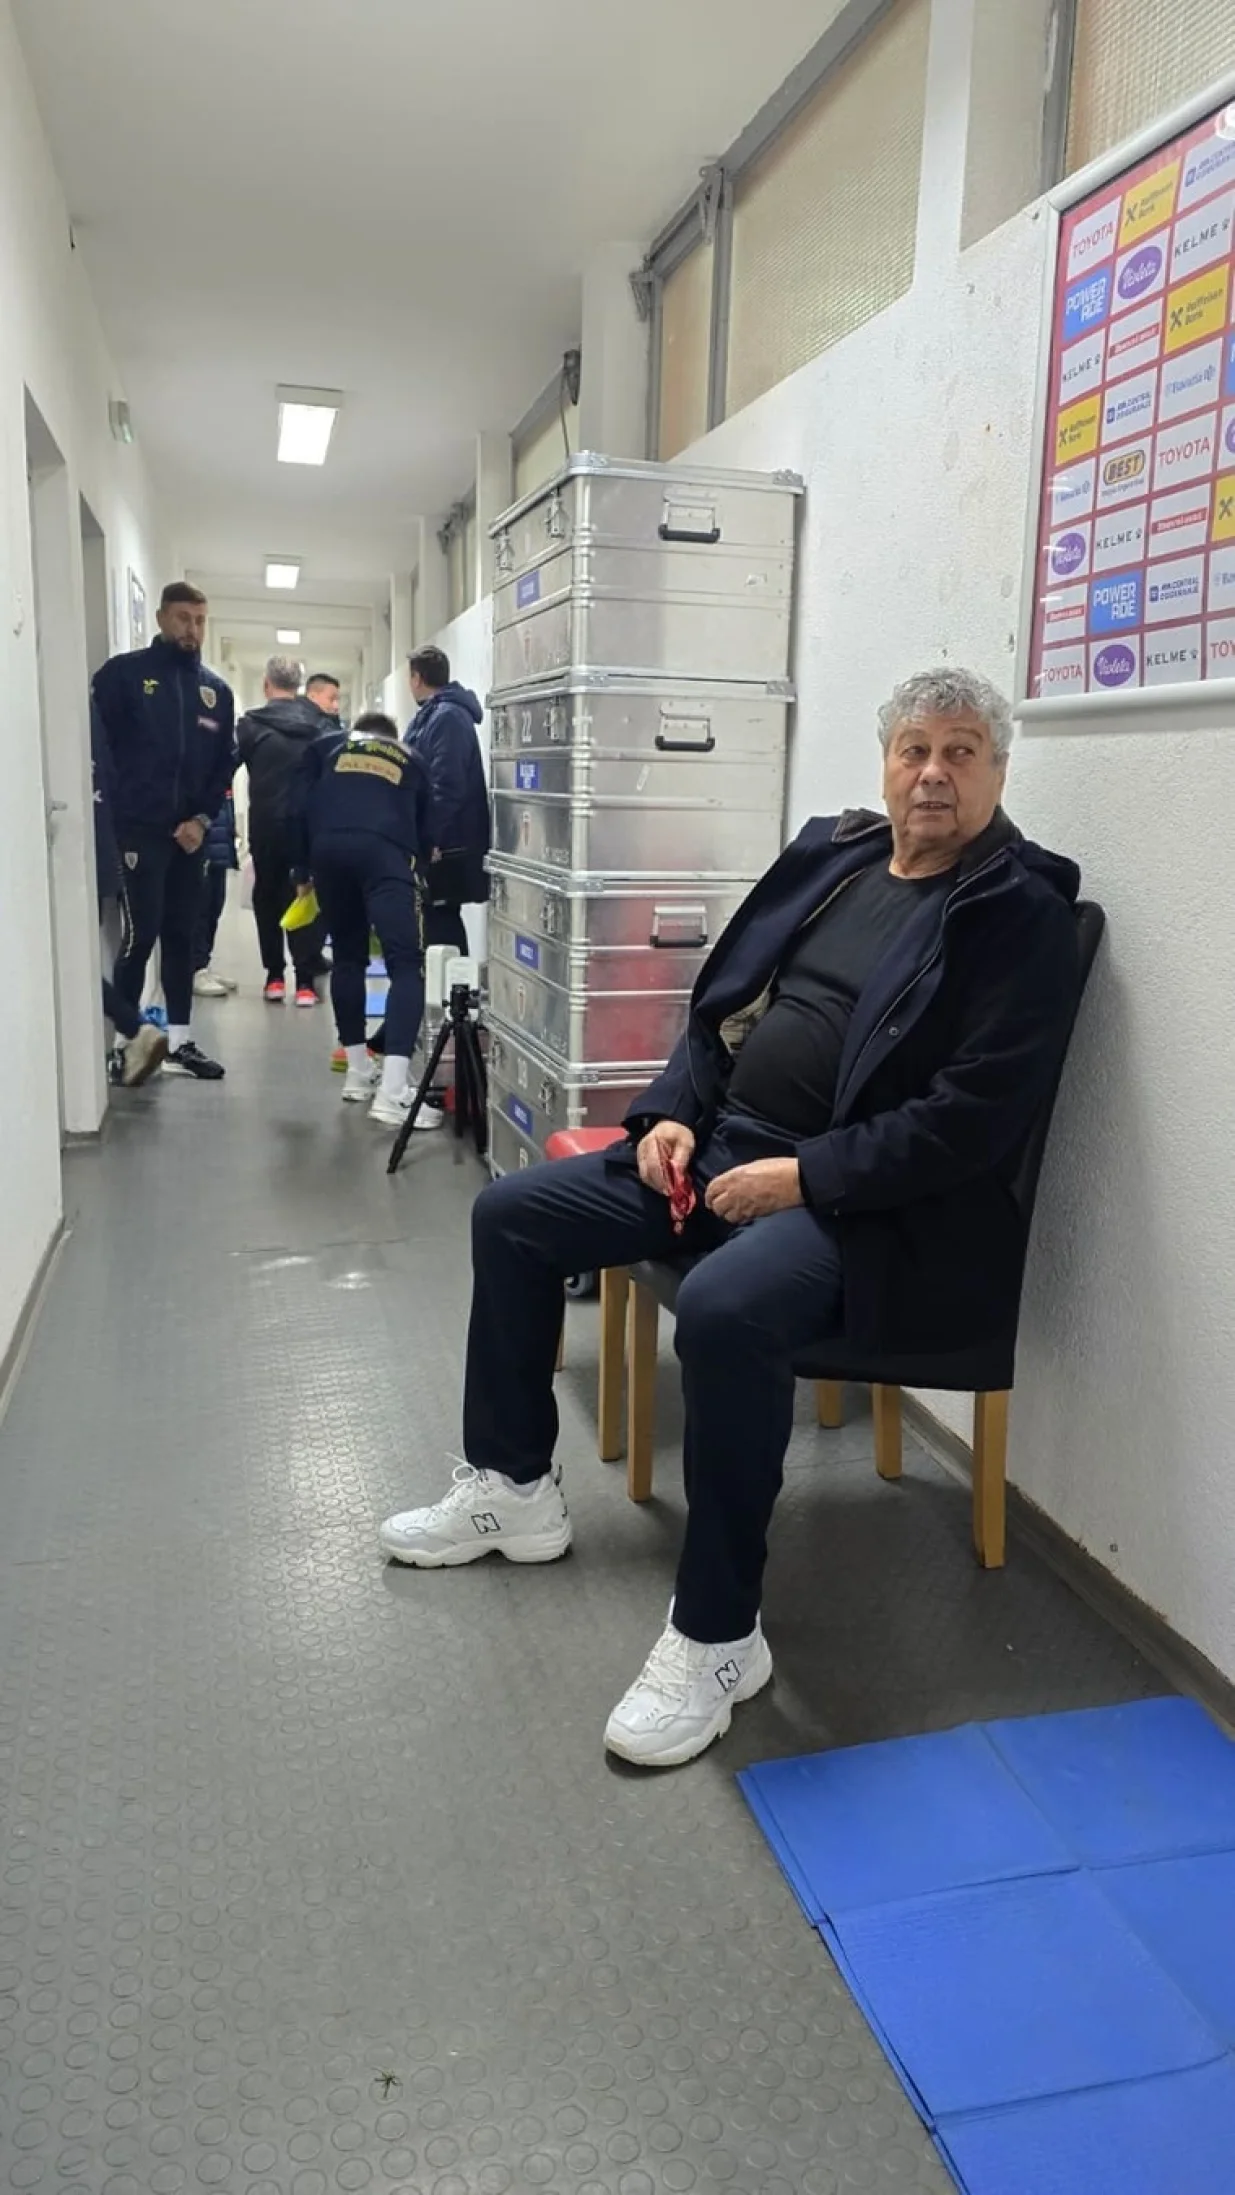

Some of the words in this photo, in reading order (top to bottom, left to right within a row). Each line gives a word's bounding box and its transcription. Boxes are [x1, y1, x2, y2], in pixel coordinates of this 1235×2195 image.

[1073, 221, 1113, 258] TOYOTA
[1174, 223, 1217, 258] KELME
[1066, 277, 1106, 315] POWER
[1080, 300, 1104, 322] ADE
[1062, 357, 1092, 382] KELME
[1158, 437, 1209, 467] TOYOTA
[1108, 453, 1141, 481] BEST
[1096, 530, 1132, 550] KELME
[1094, 582, 1137, 607] POWER
[1112, 600, 1137, 620] ADE
[1147, 650, 1186, 667] KELME
[1044, 664, 1082, 682] TOYOTA
[471, 1513, 501, 1534] N
[715, 1659, 740, 1692] N
